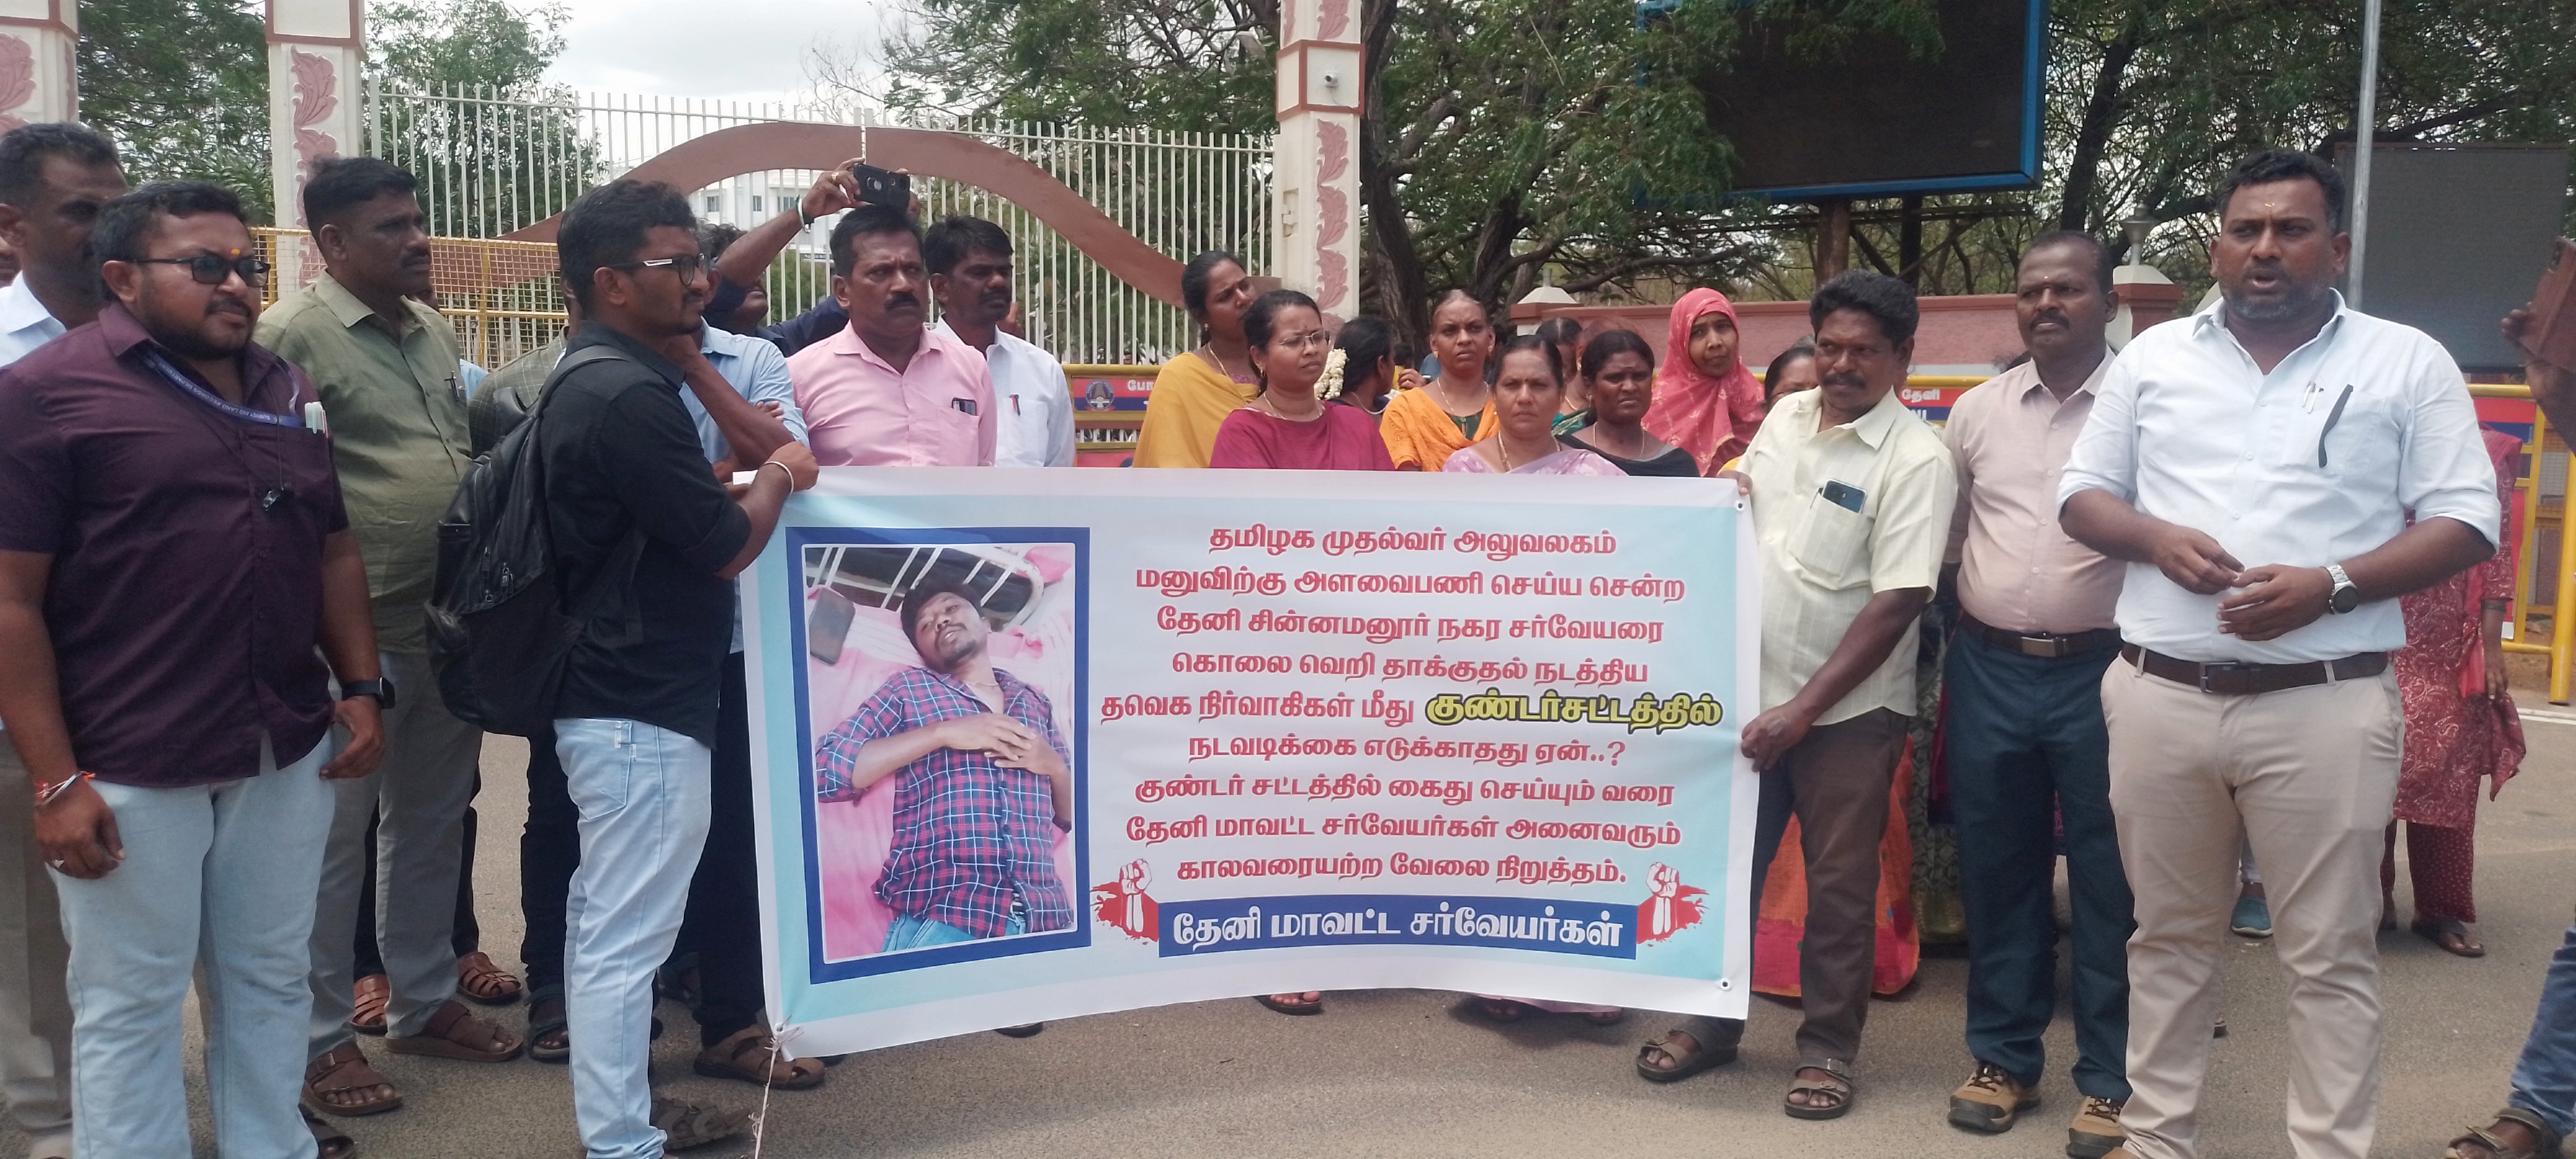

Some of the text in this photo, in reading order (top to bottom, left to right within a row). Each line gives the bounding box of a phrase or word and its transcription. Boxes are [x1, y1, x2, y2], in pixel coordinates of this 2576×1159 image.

[193, 387, 222, 406] RECORDS
[222, 404, 238, 413] LAND
[1901, 388, 1940, 404] தேனி
[250, 412, 270, 420] SURVEY
[1210, 524, 1618, 562] தமிழக முதல்வர் அலுவலகம்
[1137, 566, 1687, 601] மனுவிற்கு அளவைபணி செய்ய சென்ற
[1157, 605, 1663, 645] தேனி சின்னமனூர் நகர சர்வேயரை
[1172, 652, 1649, 686] கொலை வெறி தாக்குதல் நடத்திய
[1101, 686, 1723, 734] தவெக நிர்வாகிகள் மீது குண்டர்சட்டத்தில்
[1189, 733, 1627, 768] நடவடிக்கை எடுக்காதது ஏன்..?
[1135, 774, 1674, 807] குண்டர் சட்டத்தில் கைது செய்யும் வரை
[1126, 813, 1682, 849] தேனி மாவட்ட சர்வேயர்கள் அனைவரும்
[1177, 853, 1627, 885] காலவரையற்ற வேலை நிறுத்தம்.
[1173, 901, 1624, 952] தேனி மாவட்ட சர்வேயர்கள்
